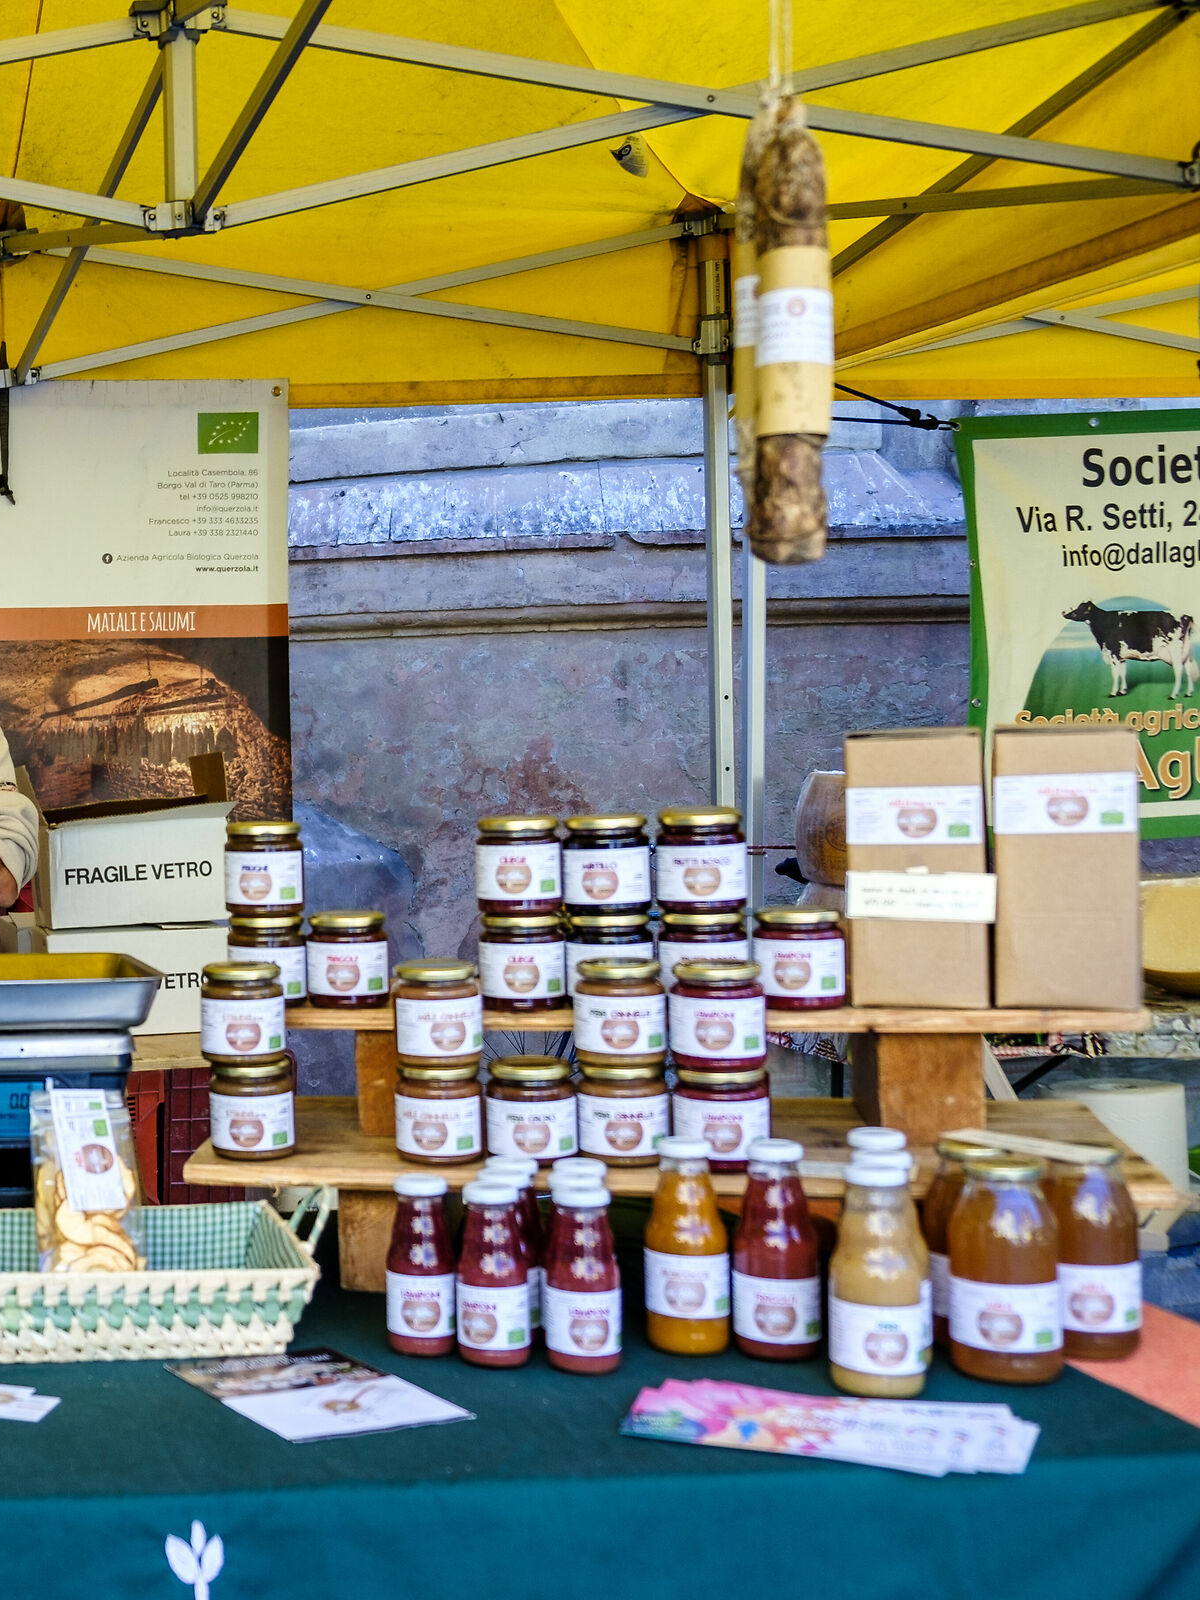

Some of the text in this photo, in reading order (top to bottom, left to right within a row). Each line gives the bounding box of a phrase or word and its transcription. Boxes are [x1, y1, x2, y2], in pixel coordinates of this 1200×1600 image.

[157, 482, 183, 491] Borgo
[184, 481, 197, 489] Val
[227, 481, 259, 489] (Parma)
[1016, 500, 1200, 533] Via R. Setti, 2
[116, 553, 259, 563] Azienda Agricola Biologica Querzola
[195, 565, 259, 574] www.querzola.it
[88, 611, 196, 633] MAIALI E SALUMI
[1125, 703, 1200, 736] agric
[64, 860, 213, 886] FRAGILE VETRO
